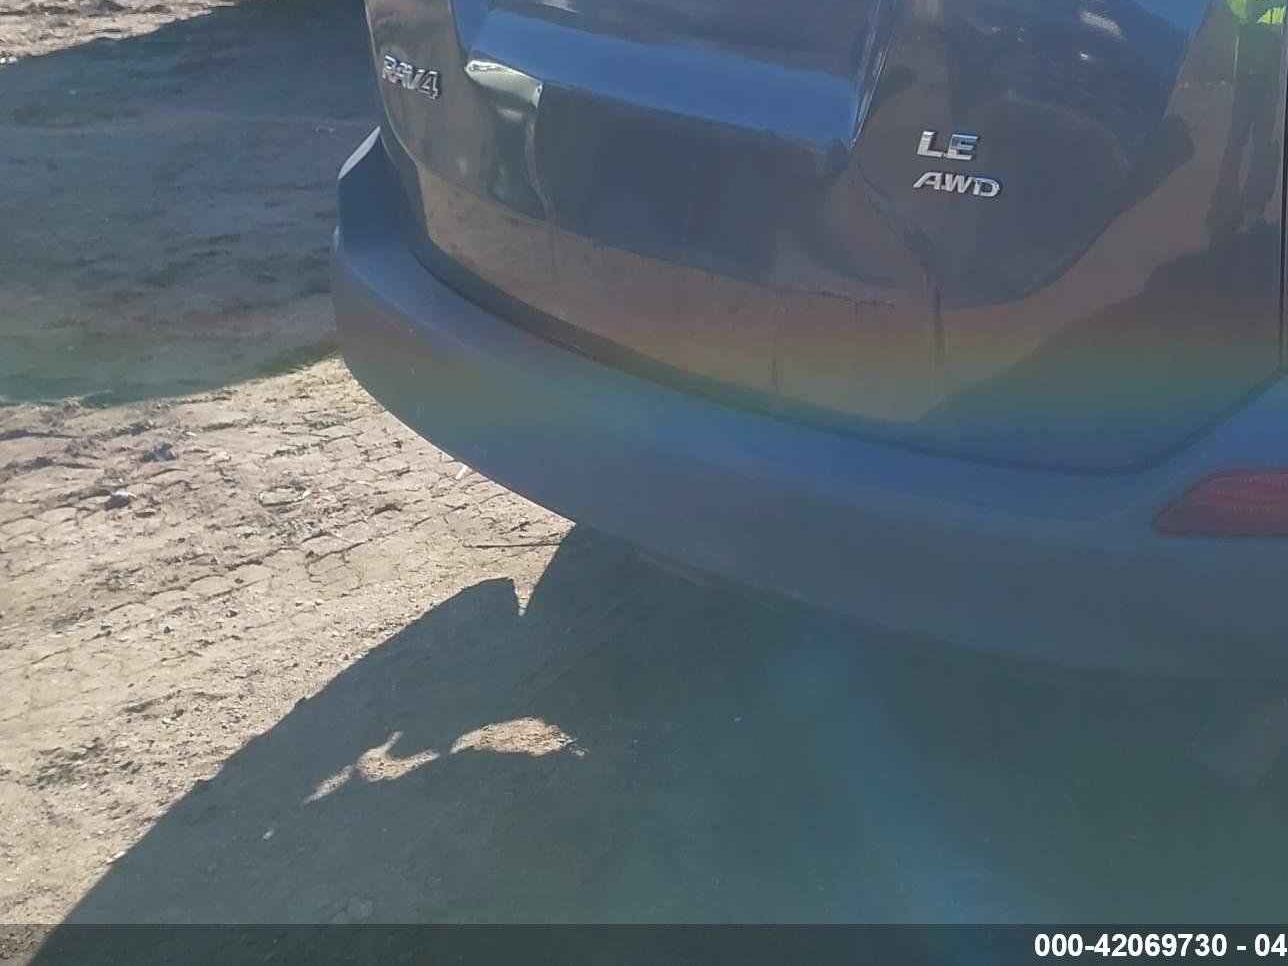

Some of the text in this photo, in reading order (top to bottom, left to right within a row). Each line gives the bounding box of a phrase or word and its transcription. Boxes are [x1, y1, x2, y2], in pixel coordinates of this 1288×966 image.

[381, 55, 439, 100] RAV4
[917, 130, 979, 161] LE
[913, 171, 1000, 197] AWD
